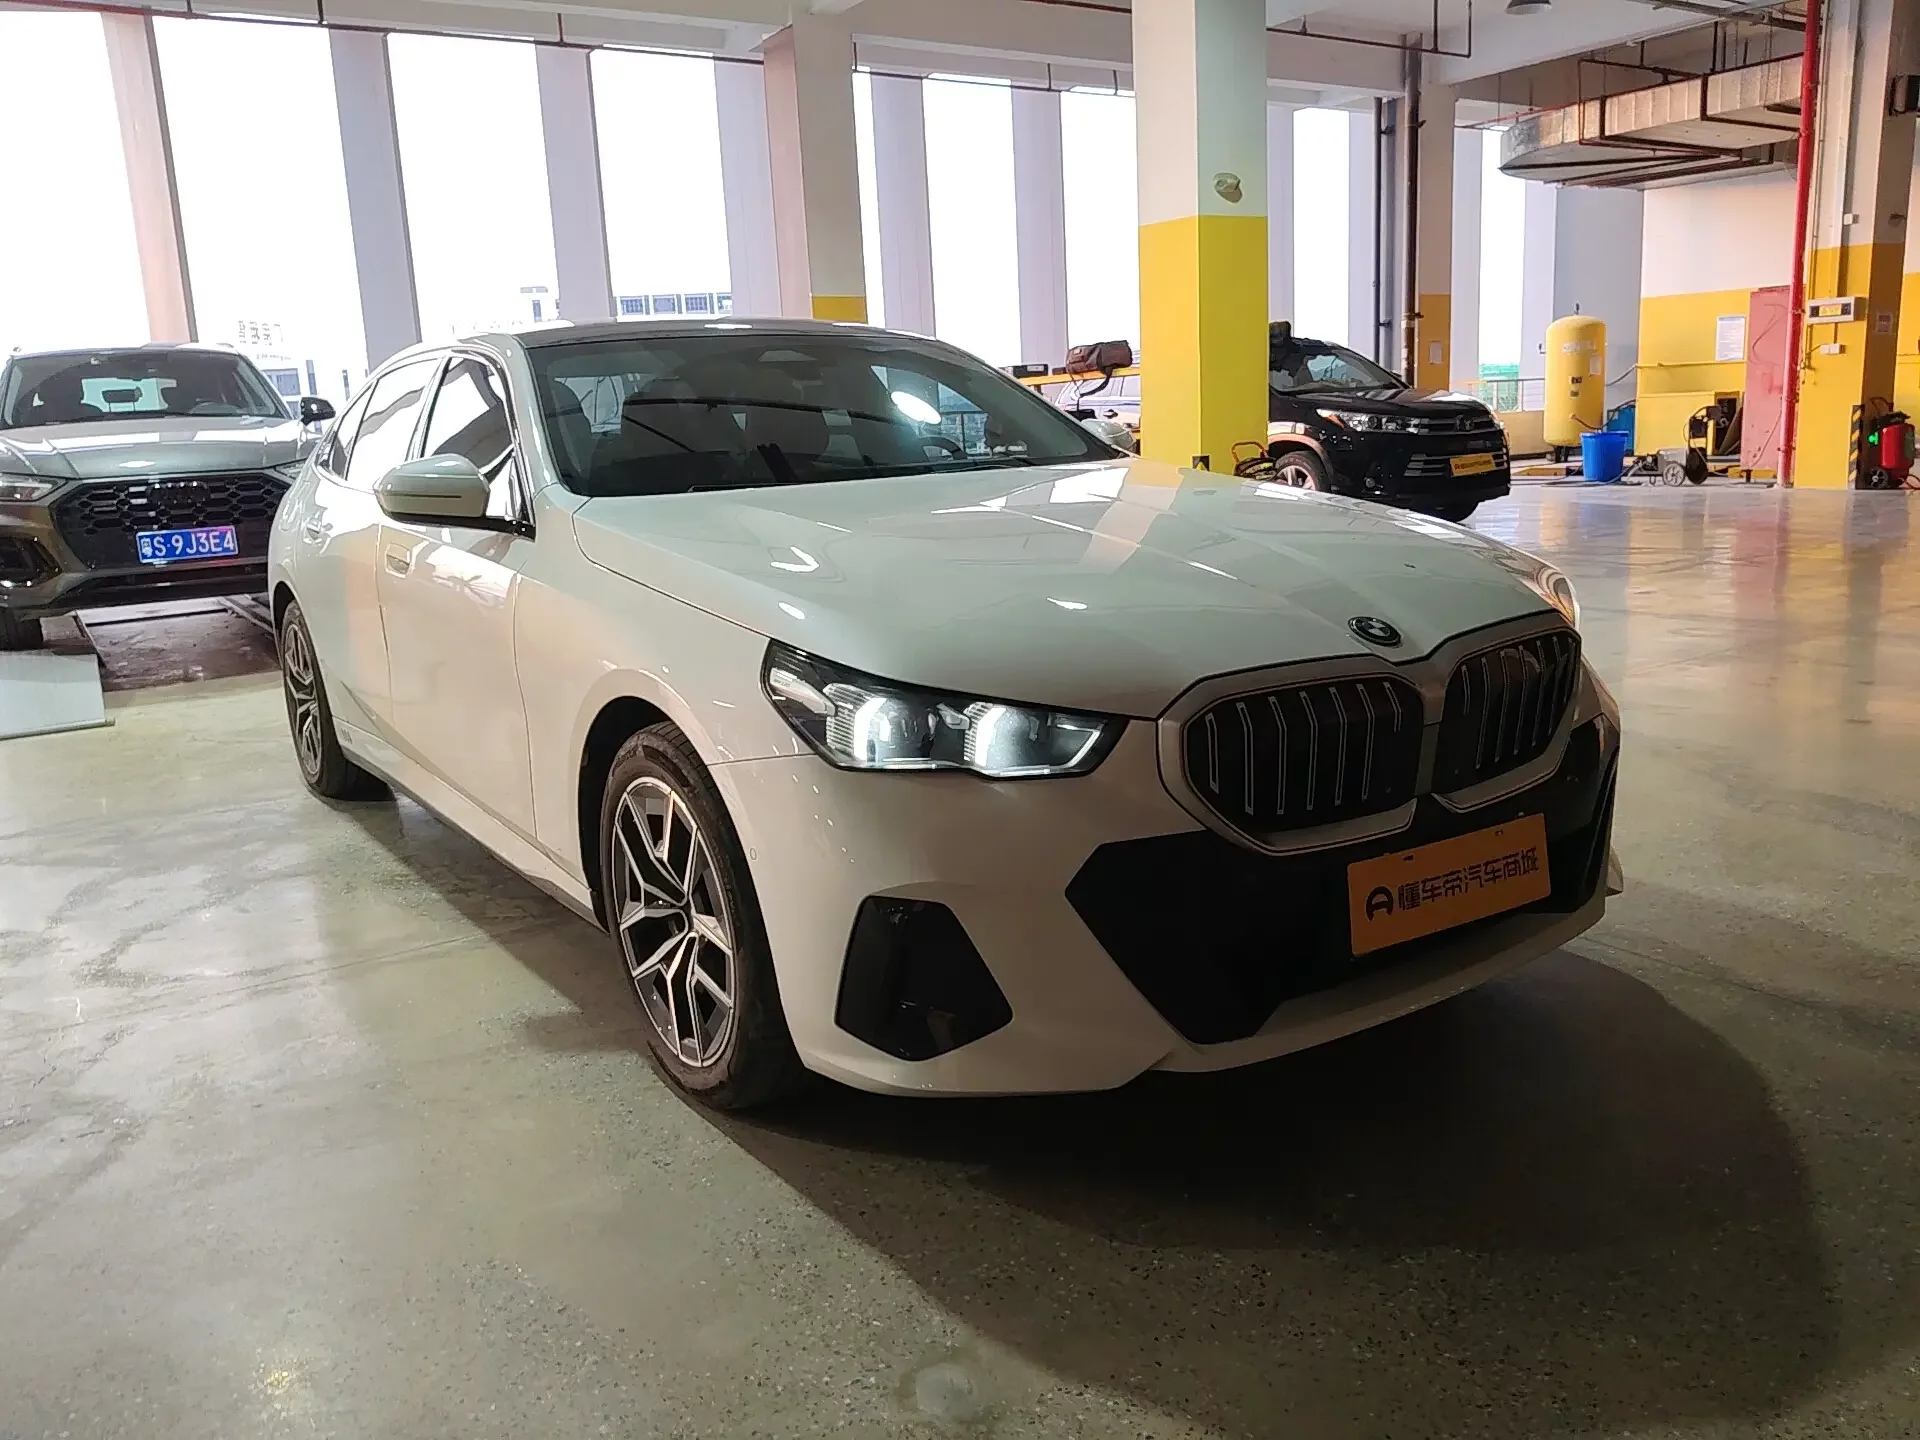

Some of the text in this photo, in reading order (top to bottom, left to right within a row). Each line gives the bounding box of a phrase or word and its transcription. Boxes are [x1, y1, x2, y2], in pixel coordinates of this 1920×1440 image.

[1398, 846, 1540, 910] 懂车帝汽车商城
